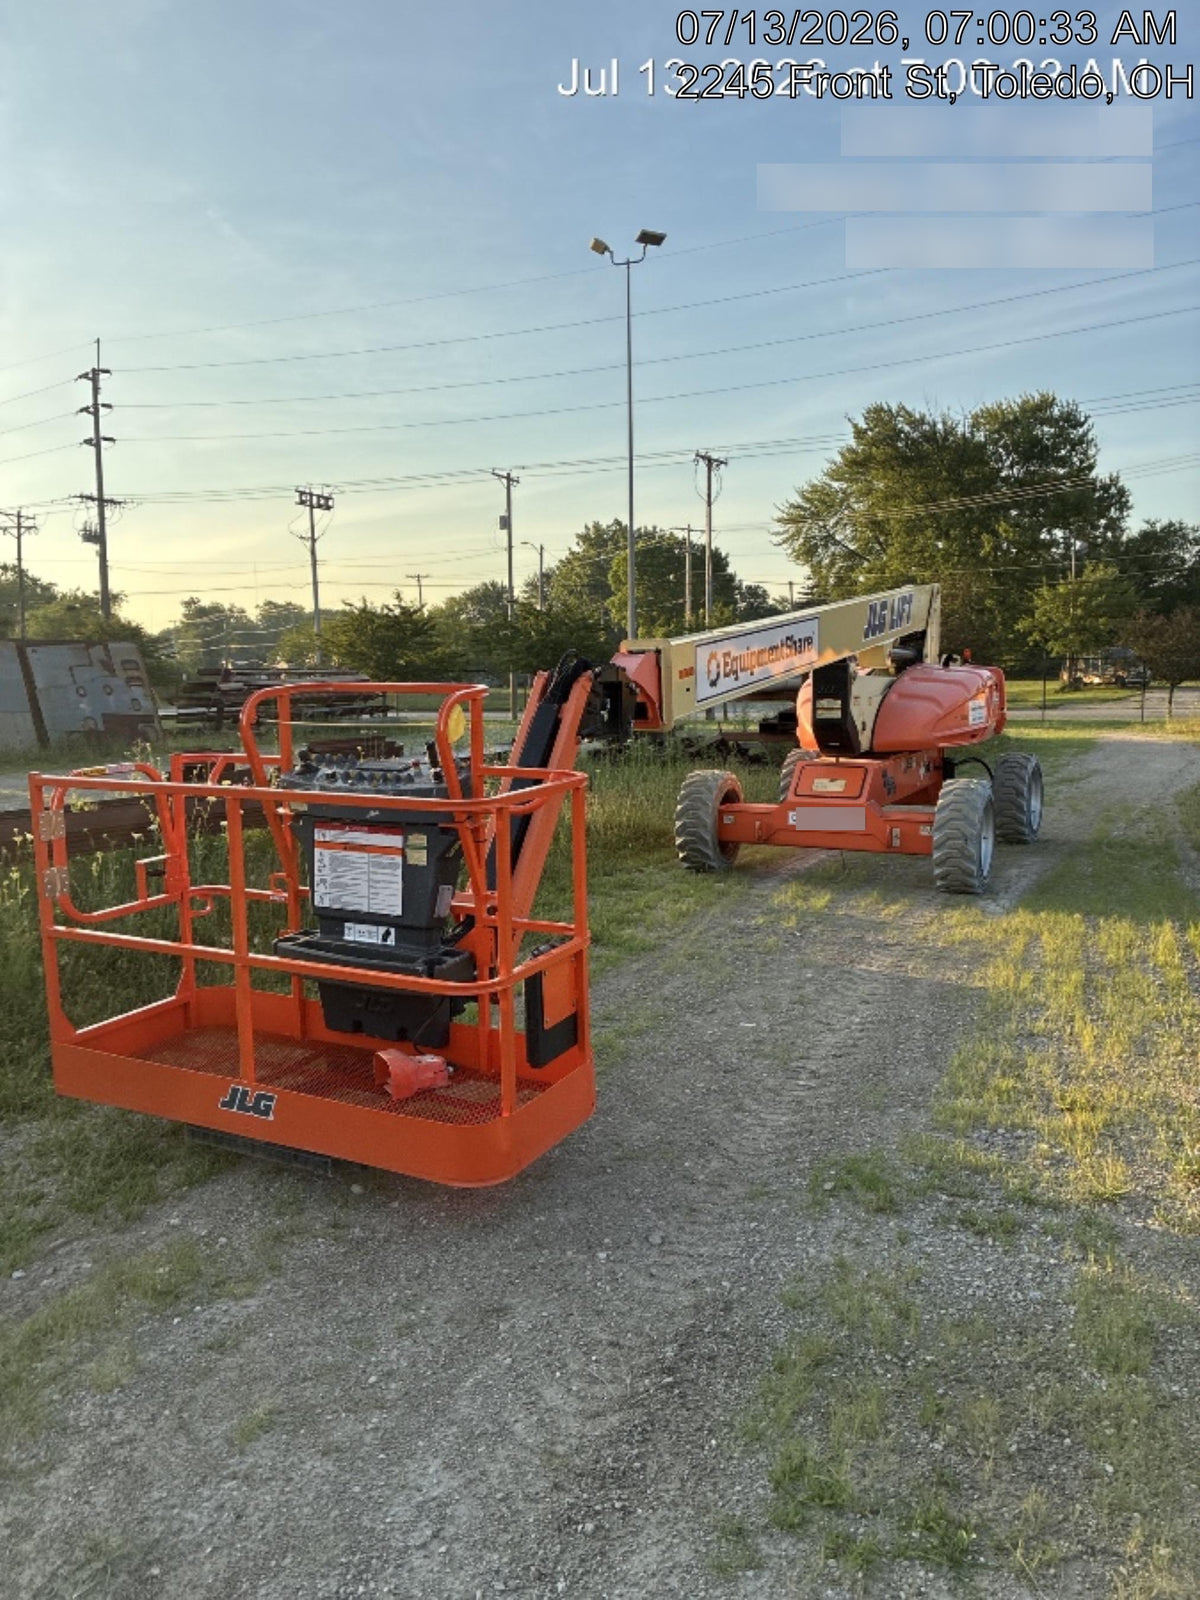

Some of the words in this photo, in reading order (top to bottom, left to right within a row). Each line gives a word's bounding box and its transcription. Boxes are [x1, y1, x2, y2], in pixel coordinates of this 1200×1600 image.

[864, 599, 888, 641] JLG
[889, 592, 914, 632] LIFT
[722, 635, 813, 681] EquipmentShare
[218, 1084, 278, 1120] JLG
